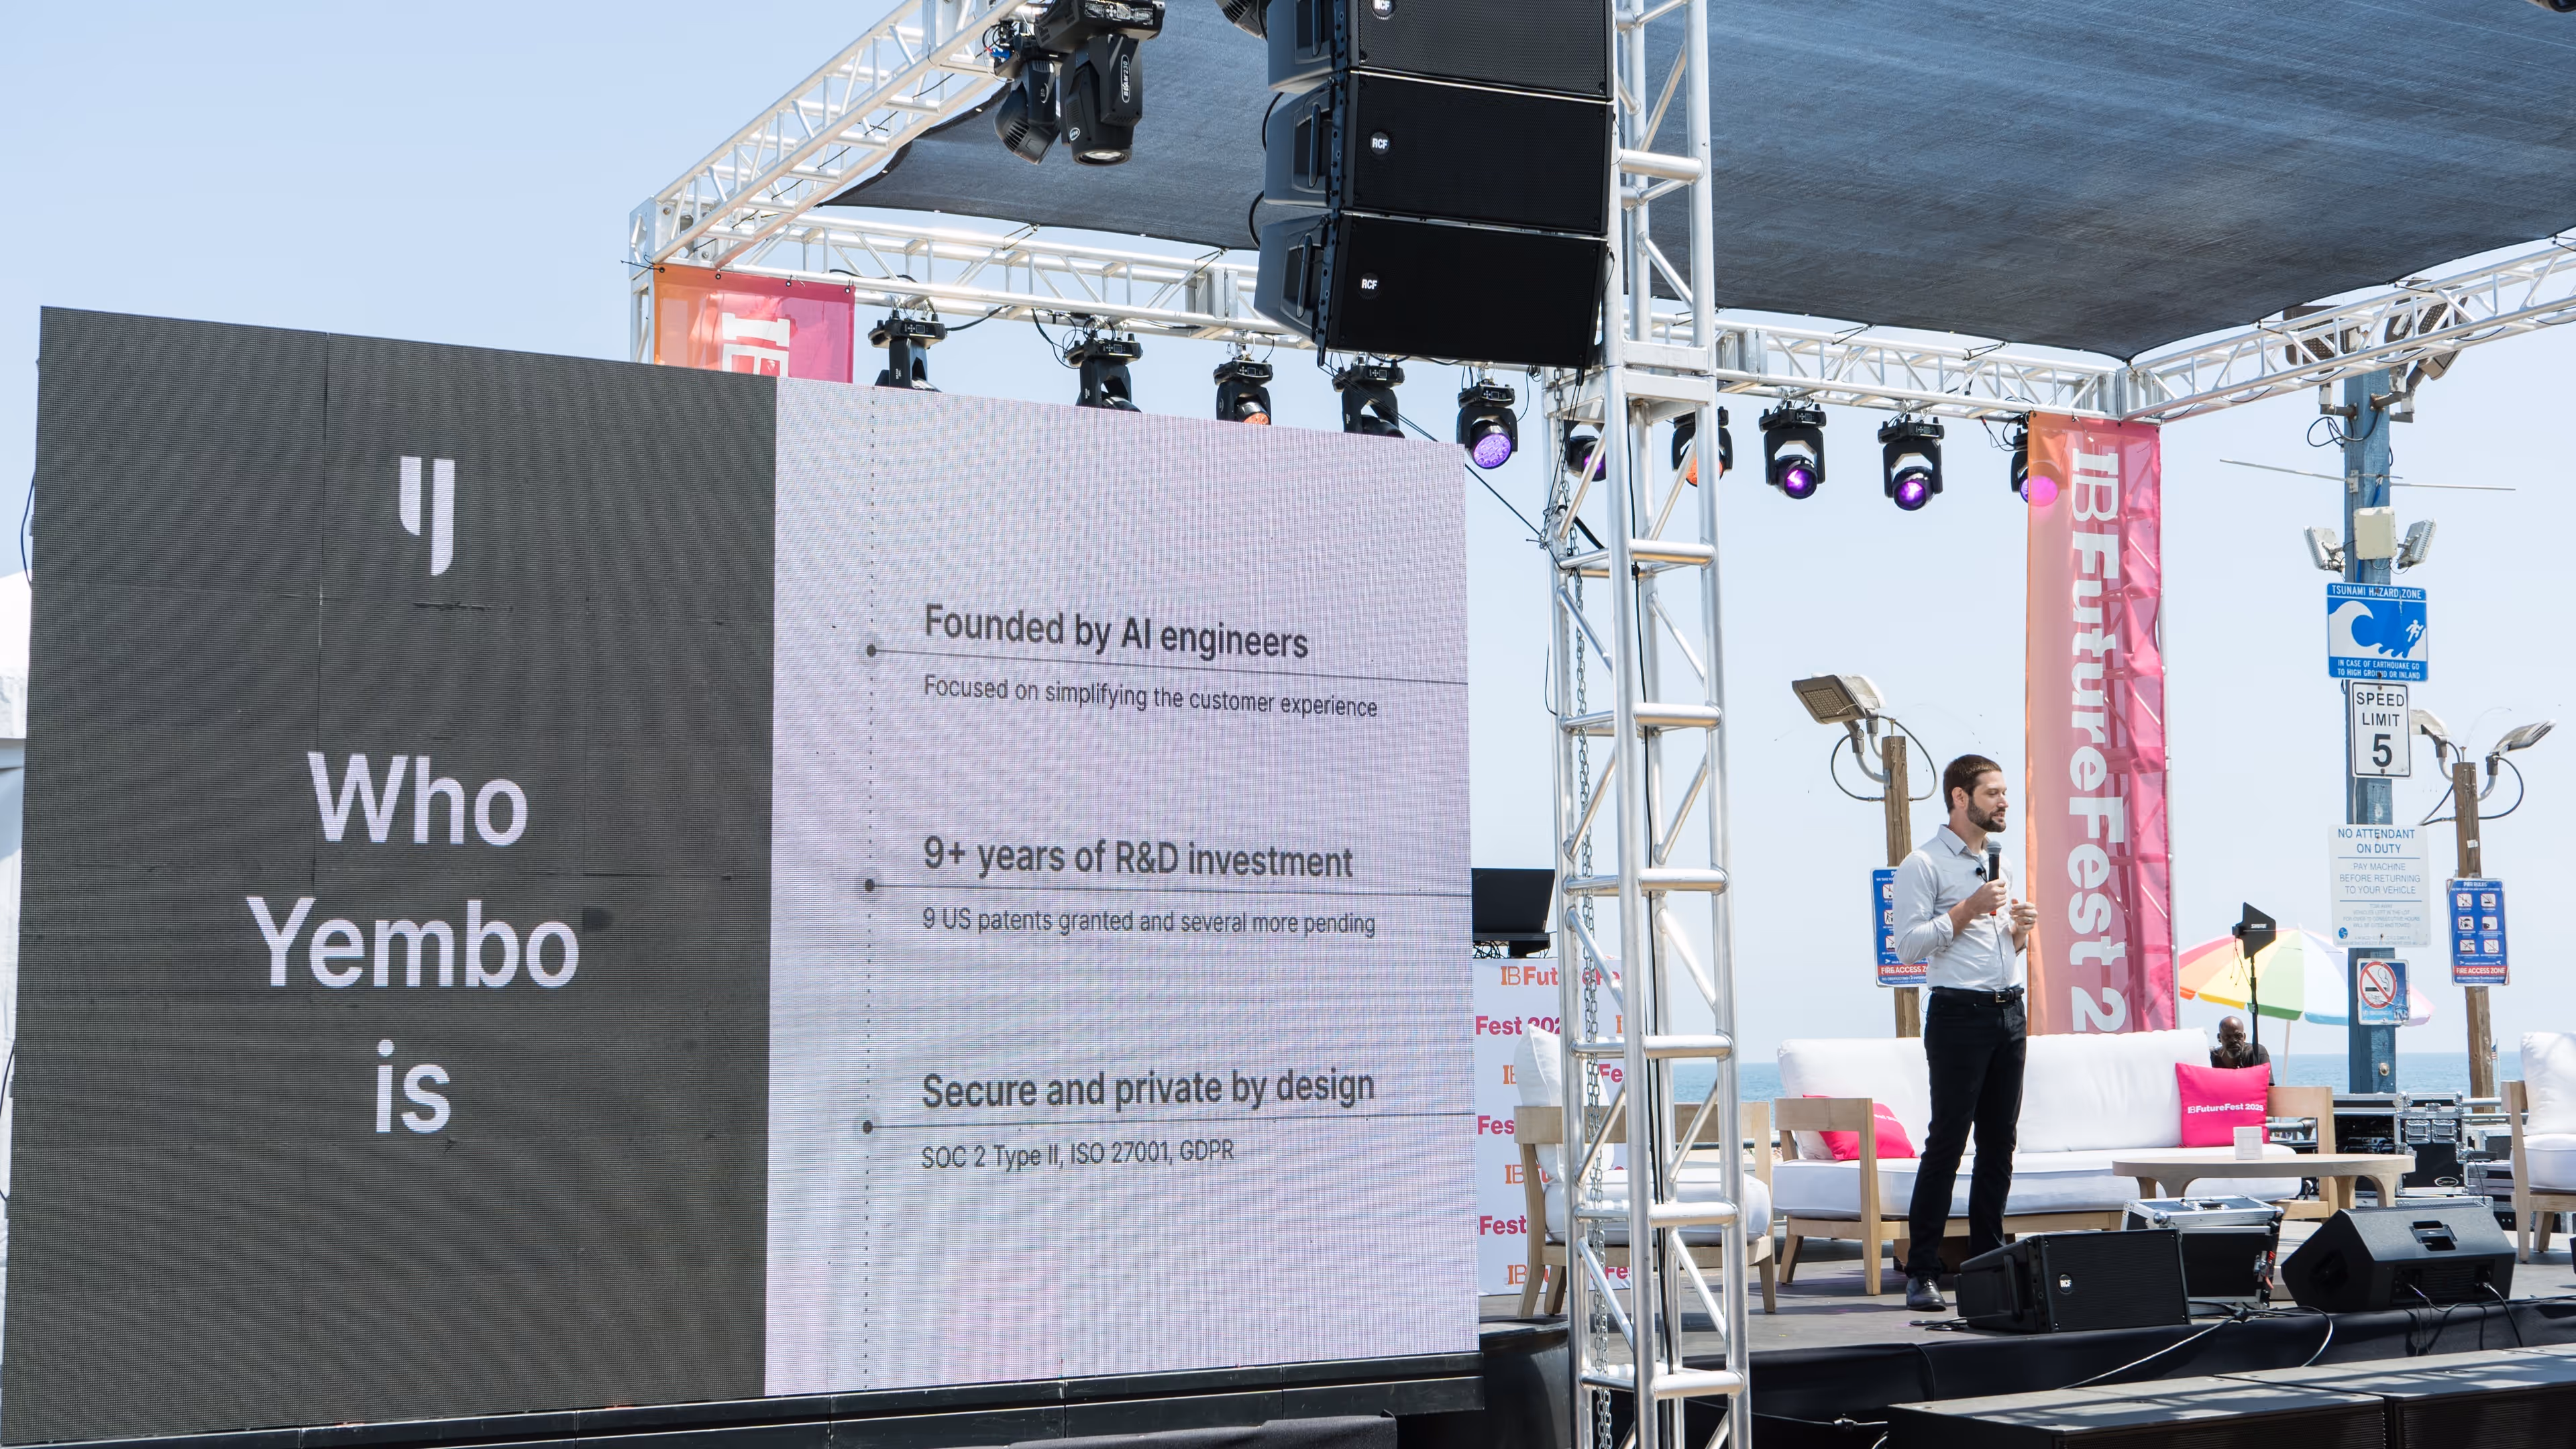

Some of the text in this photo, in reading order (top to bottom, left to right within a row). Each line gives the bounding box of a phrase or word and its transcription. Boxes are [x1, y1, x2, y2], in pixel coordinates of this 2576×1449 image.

[1372, 138, 1388, 150] RCF
[1361, 279, 1378, 290] RCF
[2332, 585, 2422, 599] TSUNAMI HAZARD ZONE
[926, 604, 1309, 661] Founded by AI engineers
[2338, 668, 2345, 676] TO
[2347, 669, 2361, 677] HIGH
[2373, 661, 2410, 670] EARTHQUAKE
[924, 672, 1377, 718] Focused on simplifying the customer experience
[2356, 692, 2405, 707] SPEED
[2068, 445, 2127, 966] IBFutureFest
[2362, 712, 2400, 727] LIMIT
[2372, 733, 2393, 767] 5
[309, 752, 527, 846] Who
[2338, 828, 2415, 839] NO ATTENDANT
[2357, 844, 2401, 853] ON DUTY
[924, 835, 1353, 879] 9+ years of R&D investment
[2340, 874, 2420, 883] BEFORE RETURNING
[2345, 885, 2416, 894] TO YOUR VEHICLE
[922, 906, 1375, 939] 9 US patents granted and several more pending
[247, 896, 578, 987] Yembo
[376, 1039, 450, 1132] is
[923, 1067, 1374, 1114] Secure and private by design
[2245, 1104, 2264, 1112] 2025
[1478, 1115, 1514, 1135] Fes
[922, 1140, 1234, 1173] SOC 2 Type II, ISO 27001, GDPR
[2060, 1279, 2072, 1287] RCF
